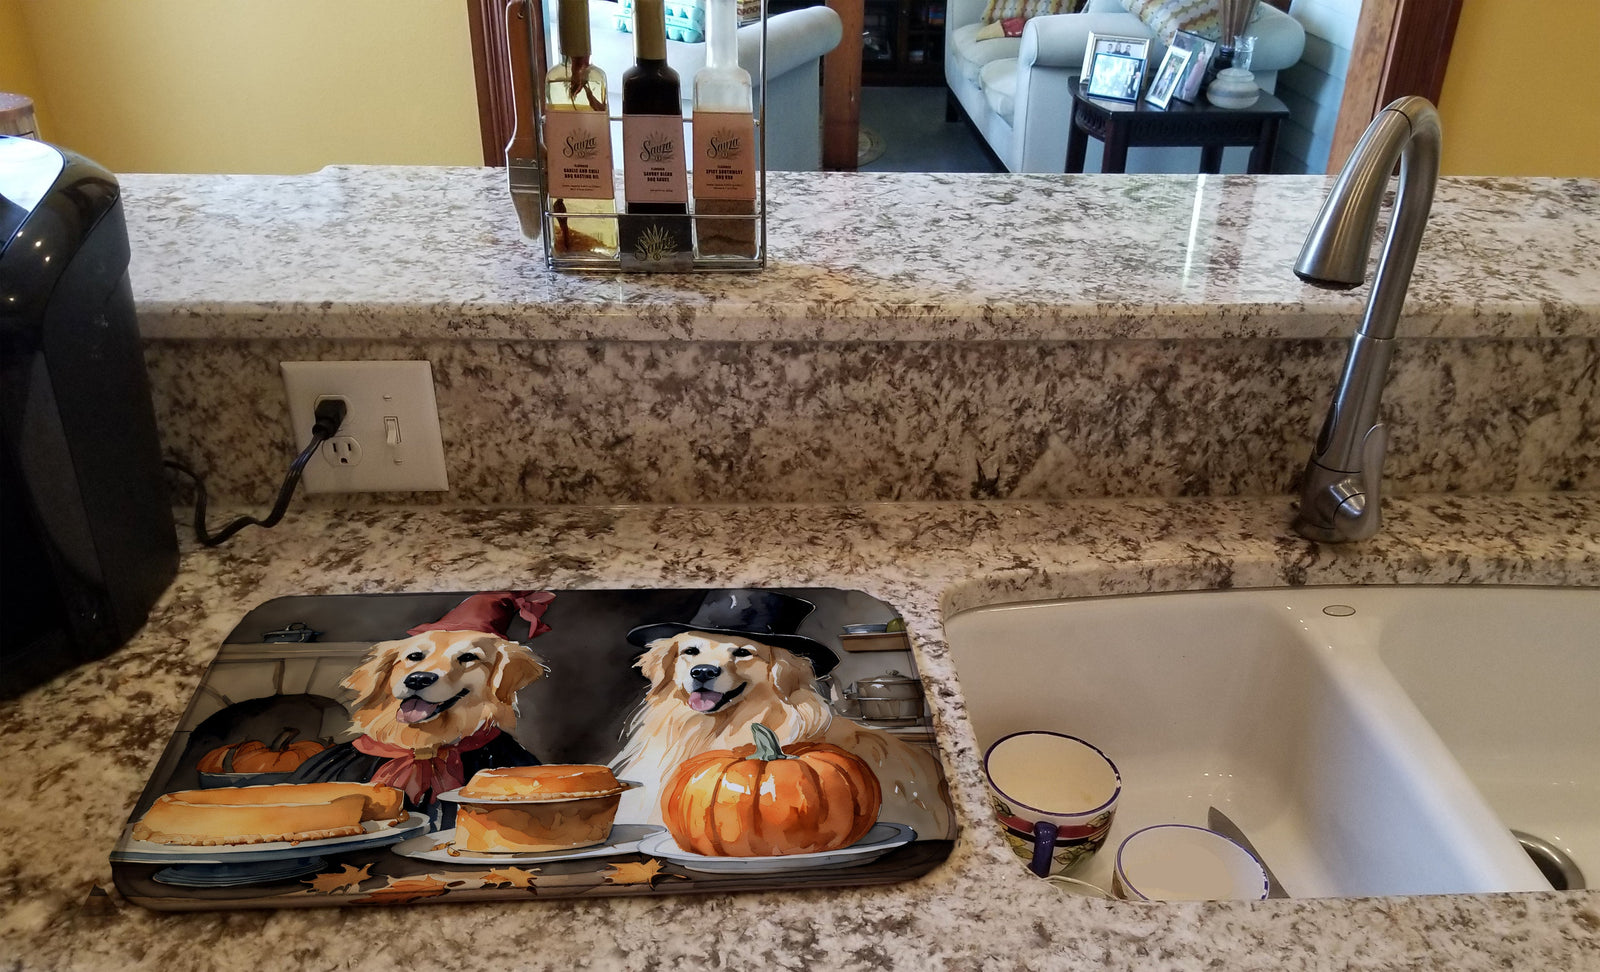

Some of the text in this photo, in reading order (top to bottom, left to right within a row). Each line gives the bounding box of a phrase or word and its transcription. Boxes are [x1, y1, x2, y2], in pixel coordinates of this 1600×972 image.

[562, 135, 598, 158] Sauza
[640, 140, 674, 162] Sauza
[706, 136, 740, 159] Sauza
